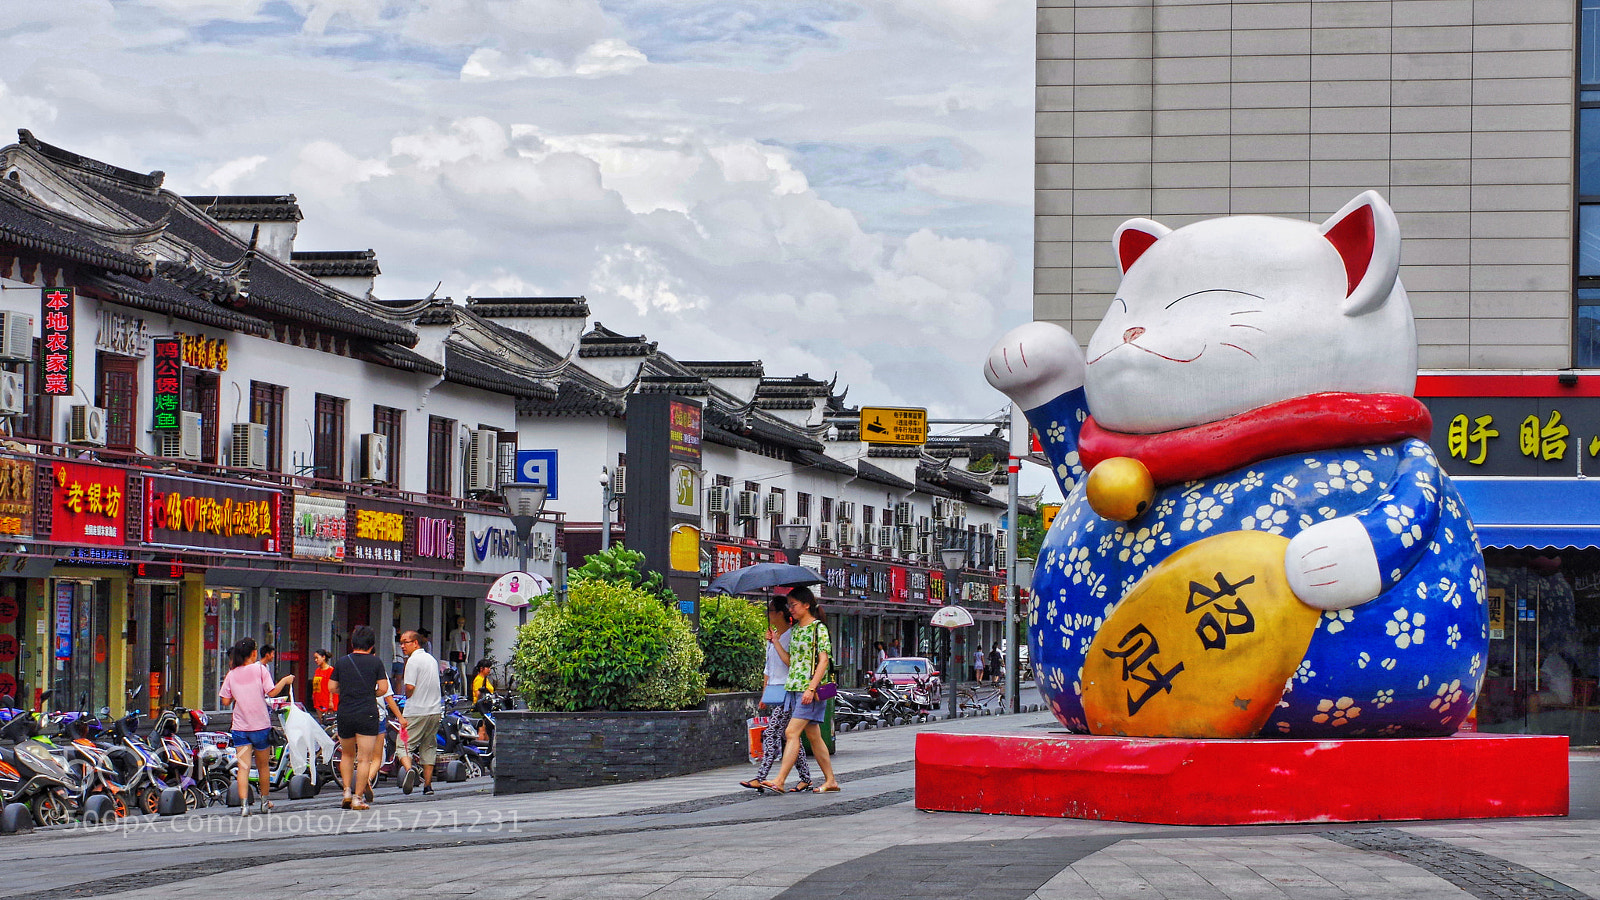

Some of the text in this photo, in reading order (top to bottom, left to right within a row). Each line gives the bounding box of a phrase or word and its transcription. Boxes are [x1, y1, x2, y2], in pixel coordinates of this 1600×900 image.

[45, 291, 69, 394] 本地农家菜
[96, 310, 149, 356] 川味烤鱼
[155, 342, 179, 429] 鸡公煲烤鱼
[1448, 409, 1600, 465] 盱眙
[68, 480, 121, 518] 老银坊
